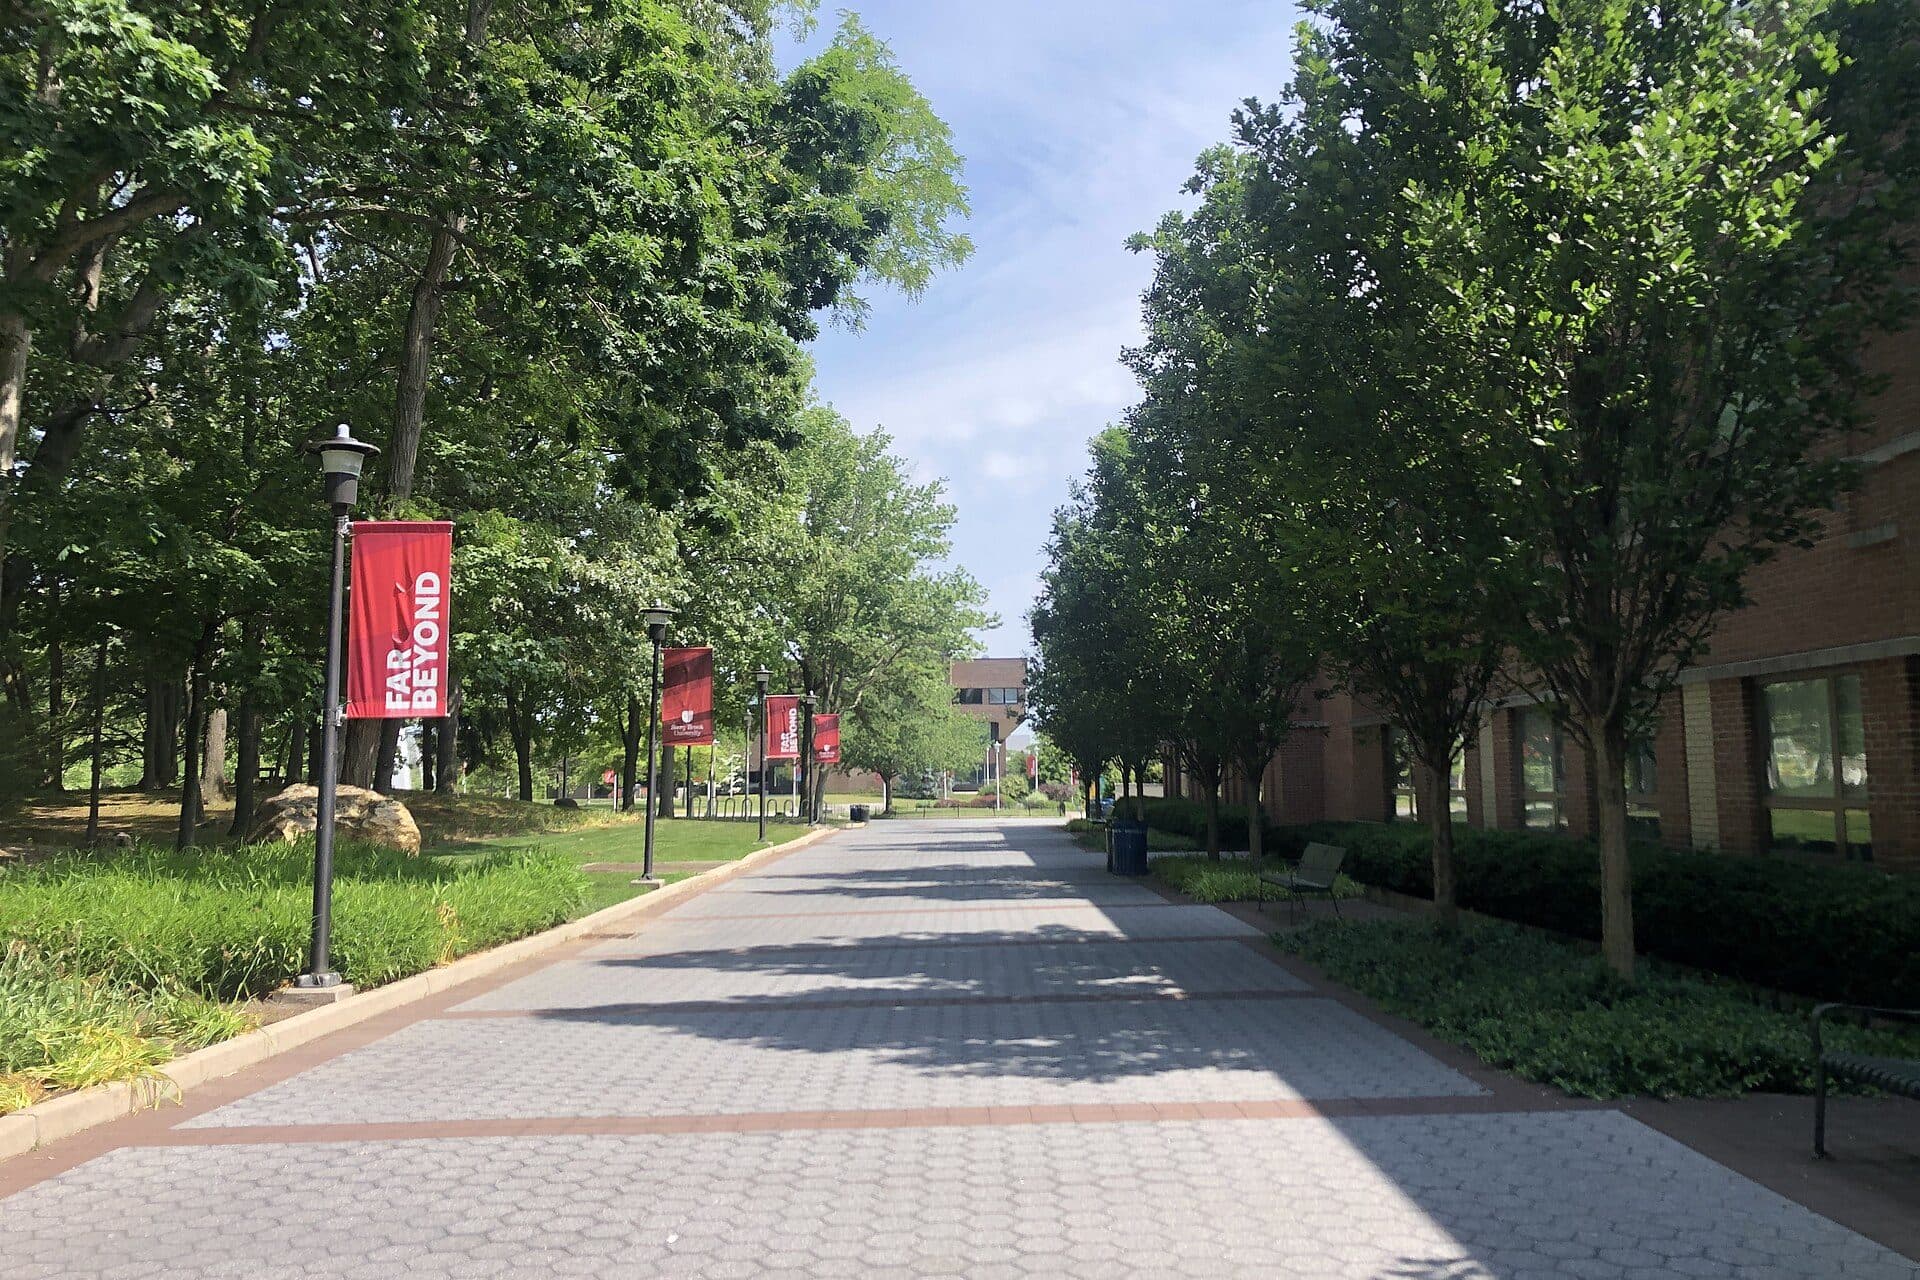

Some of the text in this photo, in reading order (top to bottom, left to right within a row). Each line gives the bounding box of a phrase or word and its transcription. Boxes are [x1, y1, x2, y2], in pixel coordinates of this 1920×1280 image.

[412, 571, 440, 709] BEYOND
[386, 649, 412, 710] FAR
[781, 732, 789, 752] FAR
[789, 708, 798, 752] BEYOND
